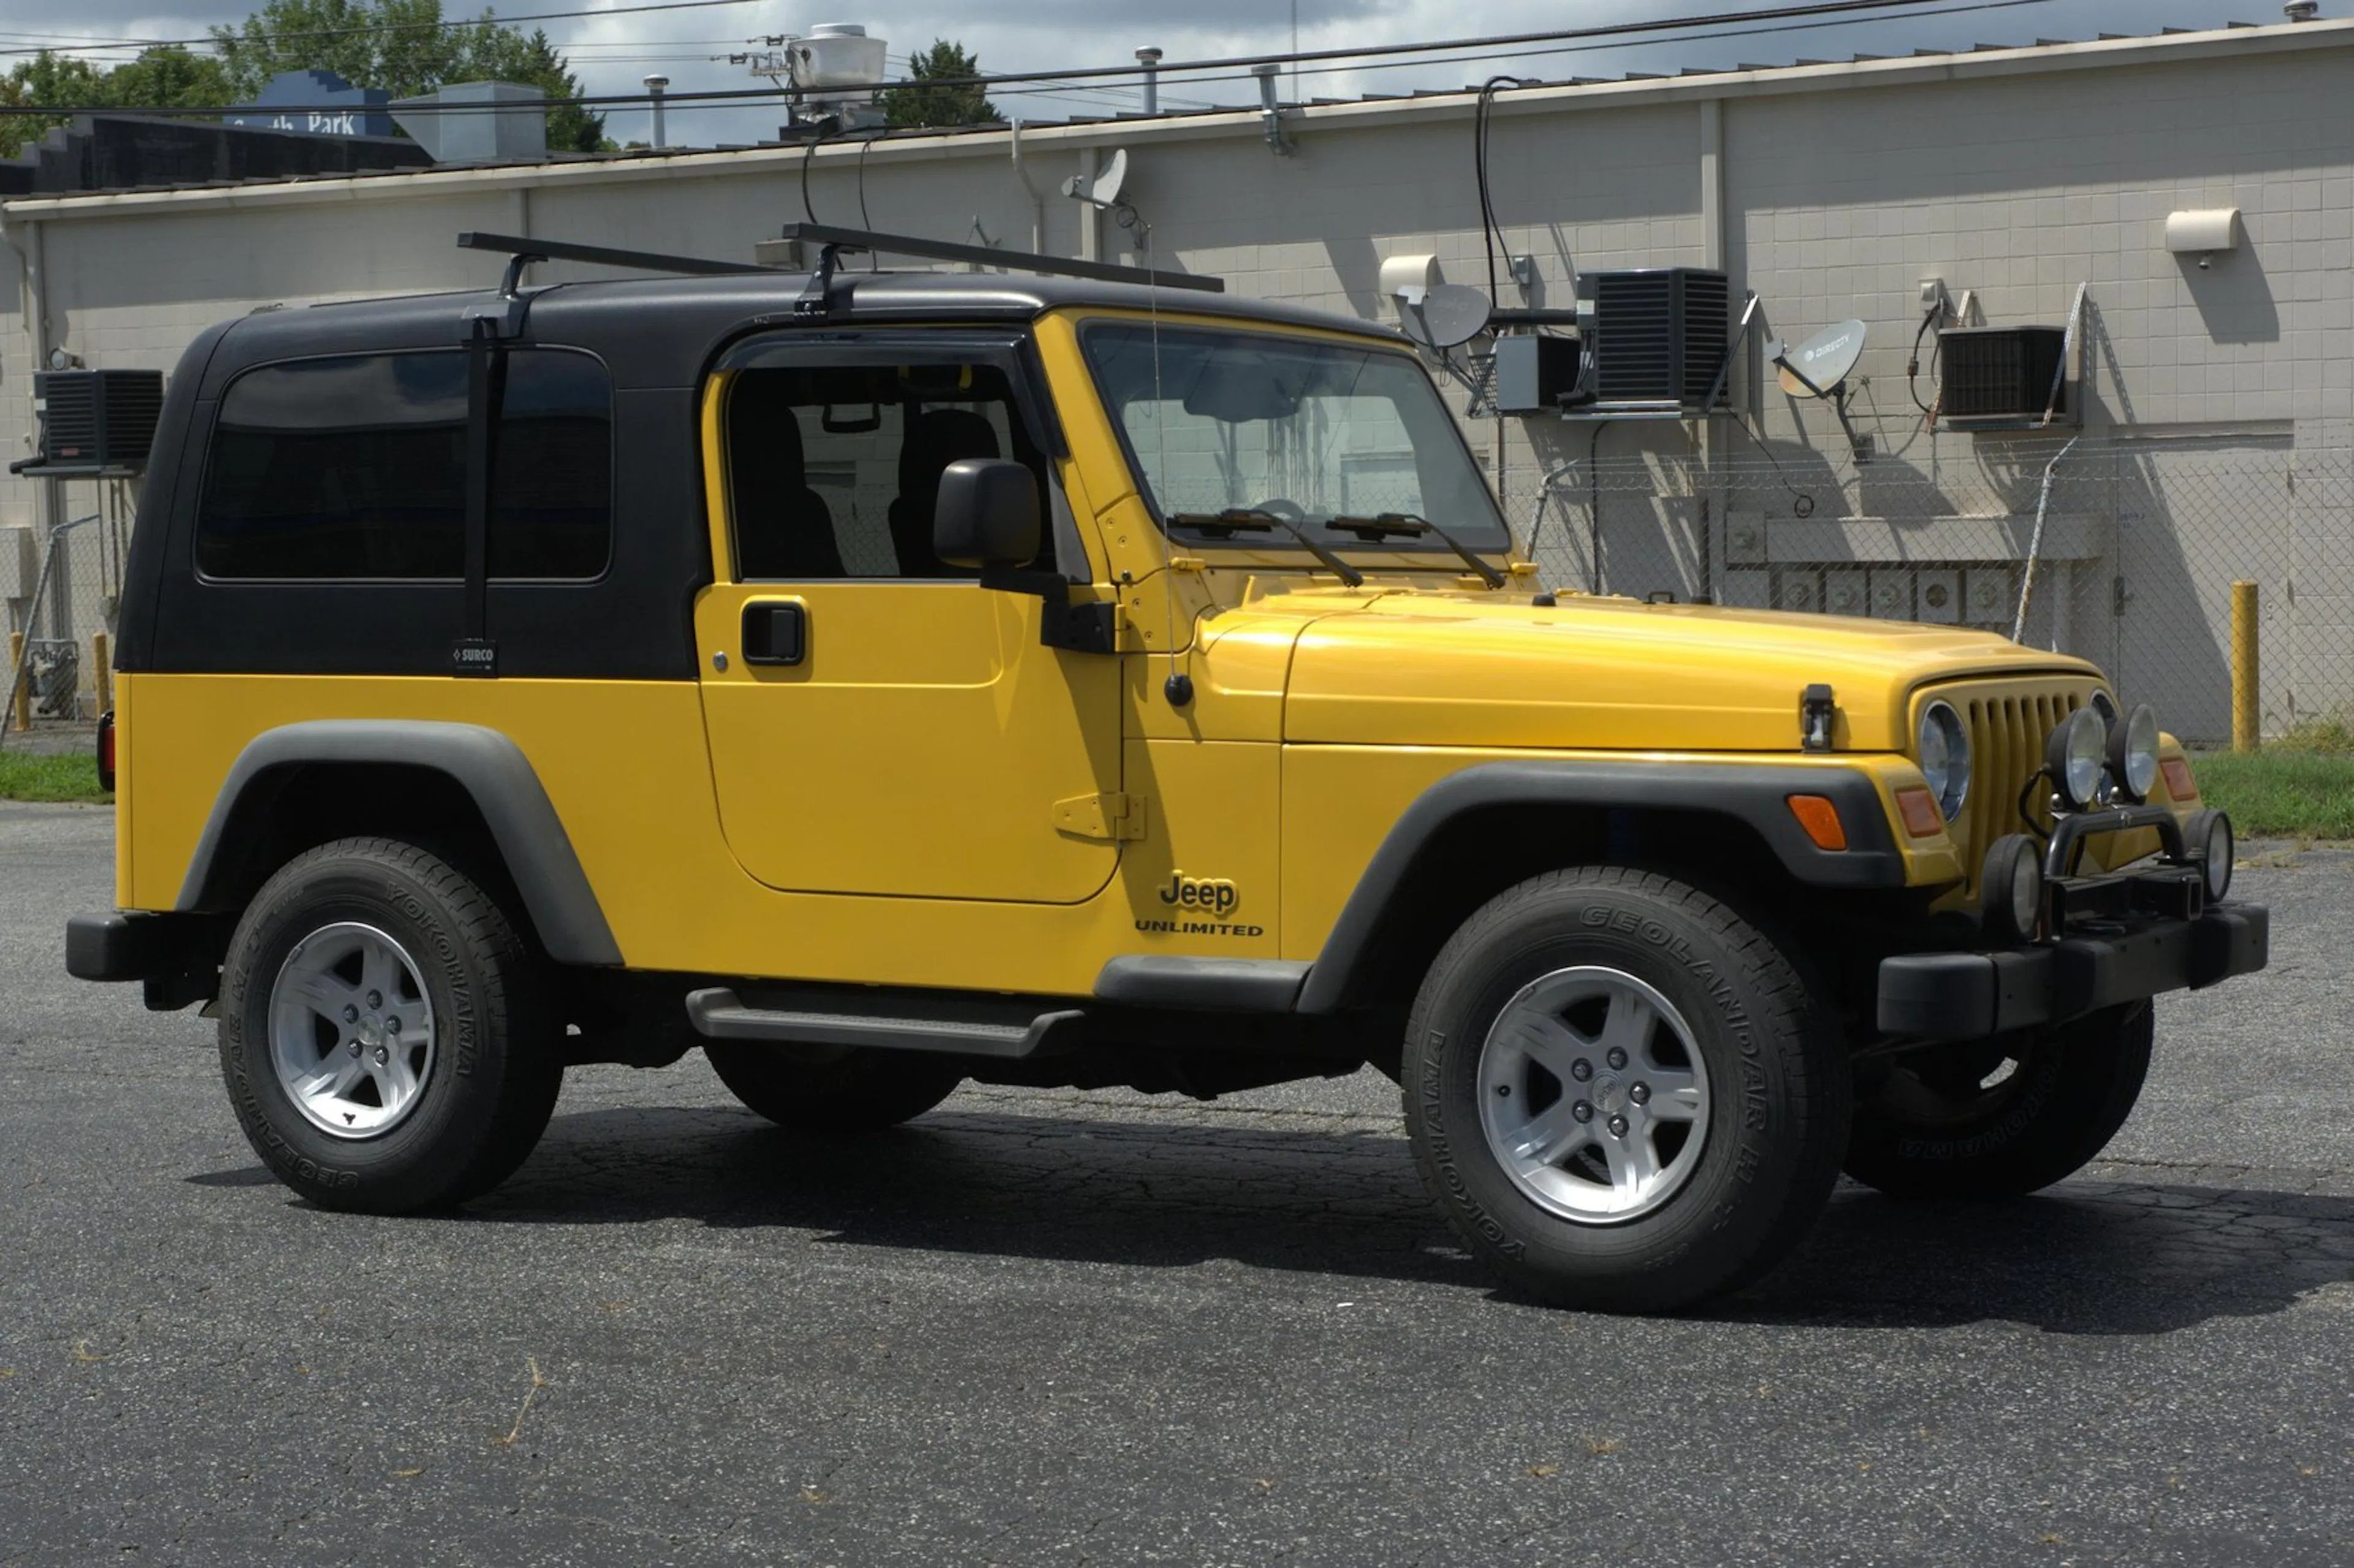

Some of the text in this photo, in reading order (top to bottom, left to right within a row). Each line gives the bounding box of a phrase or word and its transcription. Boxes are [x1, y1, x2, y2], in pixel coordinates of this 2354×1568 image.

[308, 111, 355, 135] Park
[462, 649, 493, 661] SURCO
[1159, 870, 1235, 913] Jeep
[1135, 919, 1264, 937] UNLIMITED
[383, 881, 477, 1077] YOKOHAMA
[1579, 905, 1769, 1133] GEOLANDAR
[1424, 1030, 1528, 1262] YOKOHAMA
